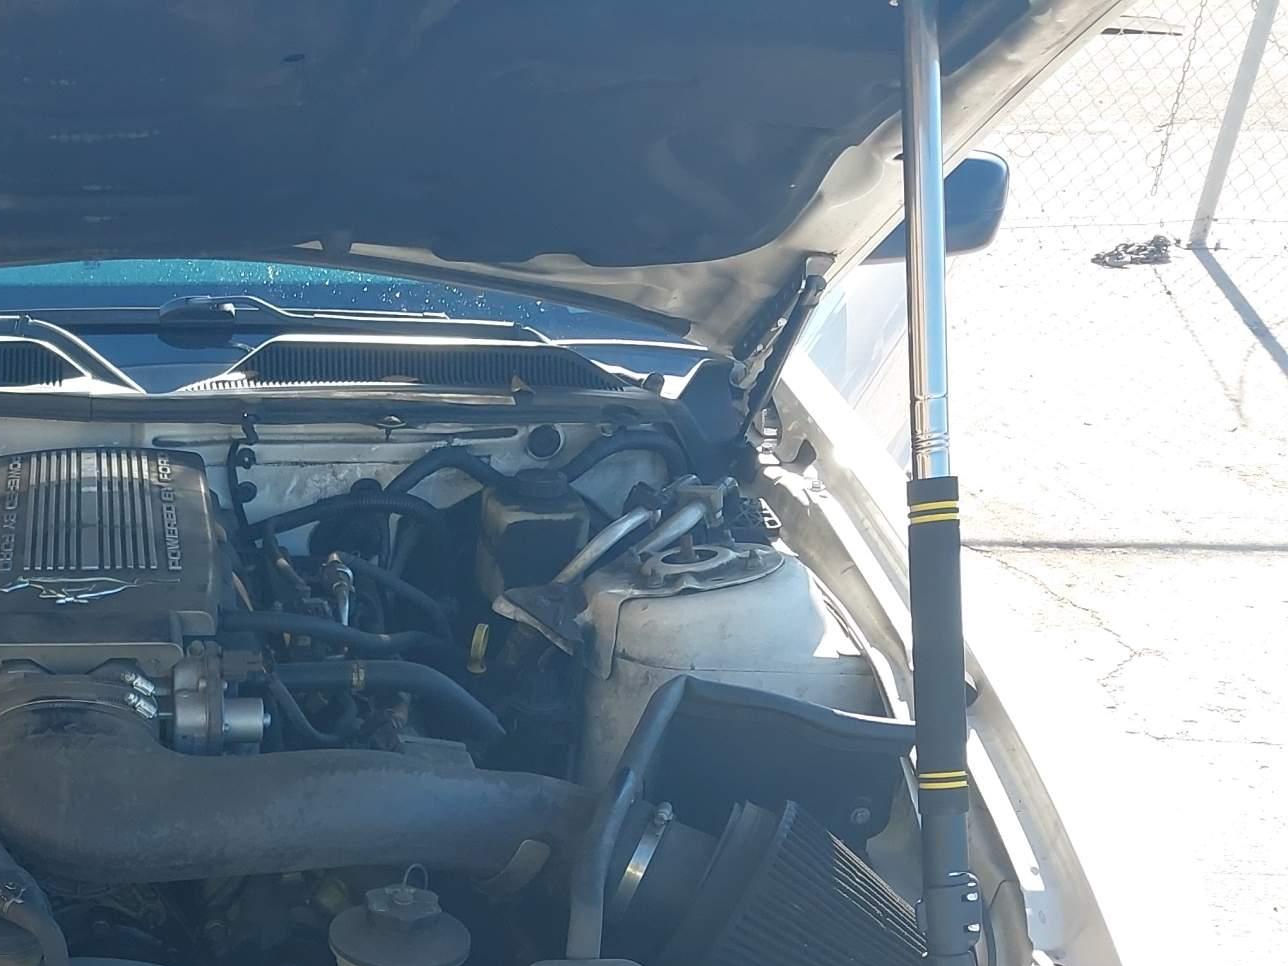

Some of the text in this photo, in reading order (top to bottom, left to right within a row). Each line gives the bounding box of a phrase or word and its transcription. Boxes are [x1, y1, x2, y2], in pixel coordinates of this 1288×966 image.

[0, 456, 22, 571] POWERED BY FORD
[162, 503, 183, 570] POWERED
